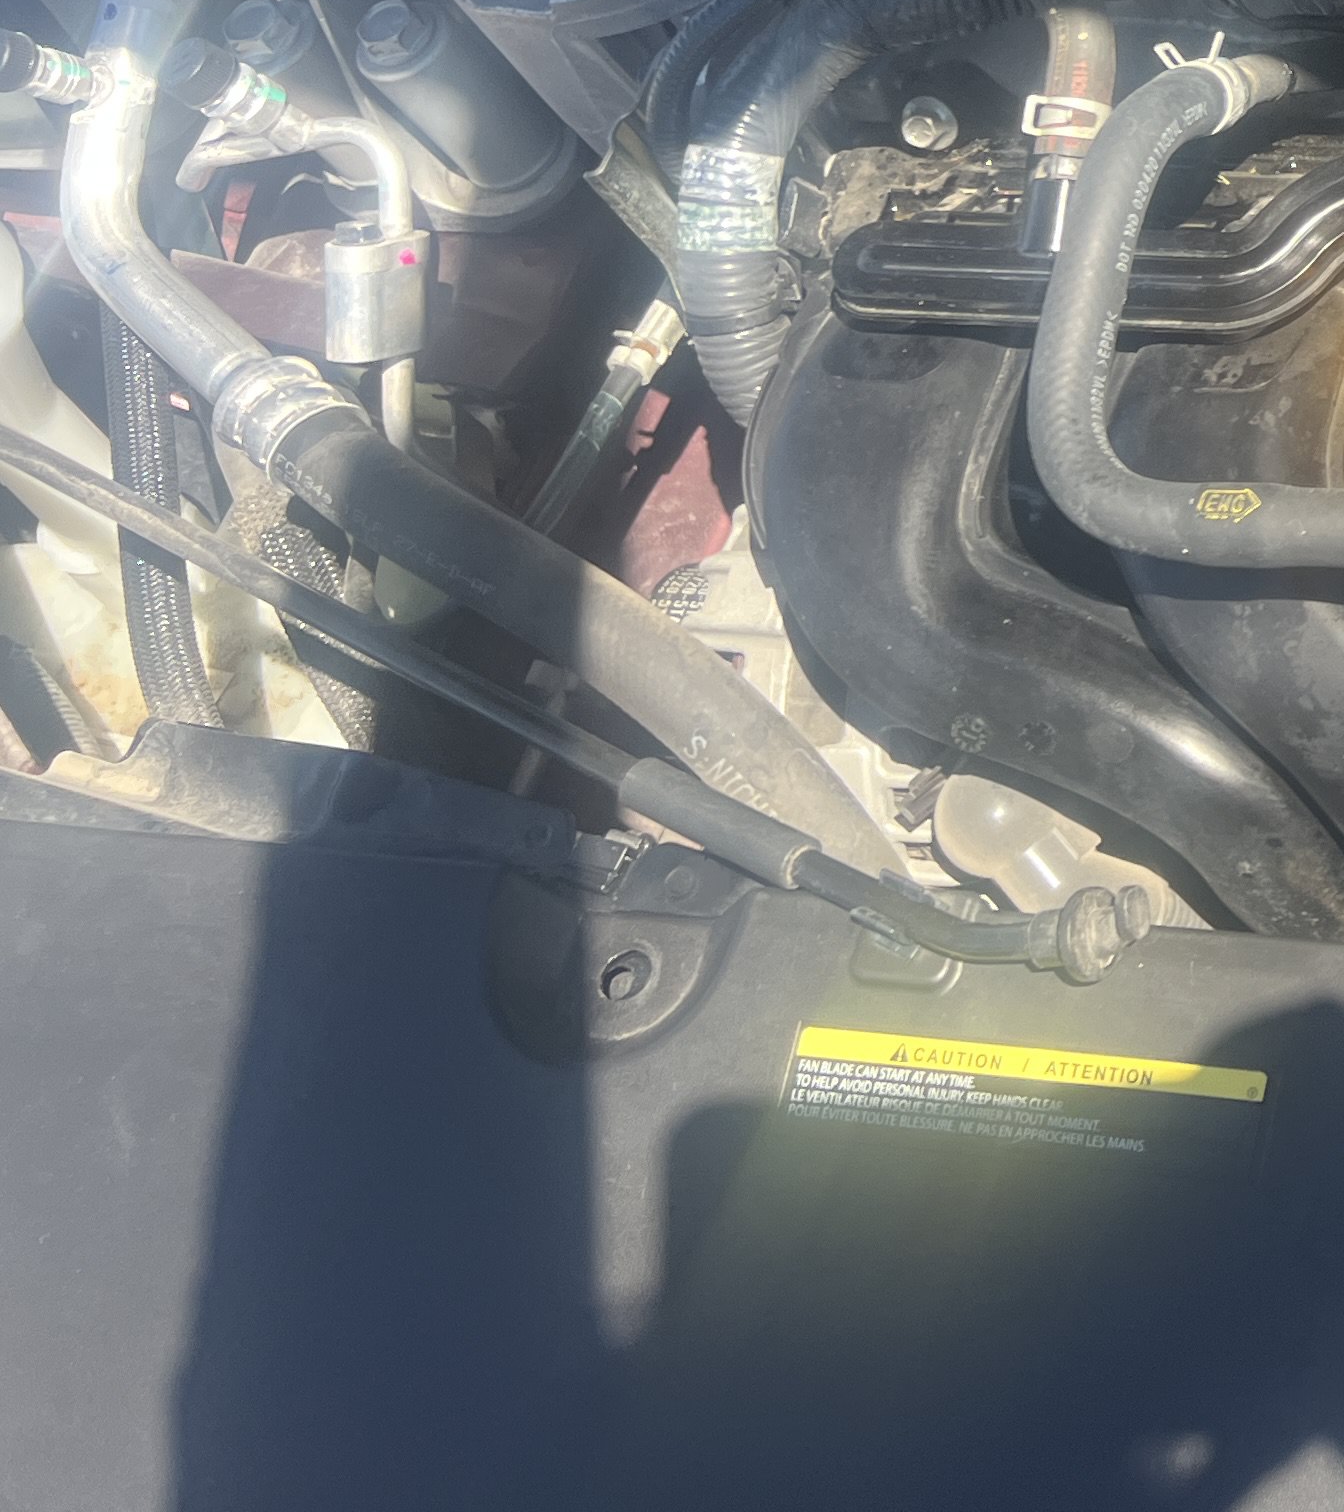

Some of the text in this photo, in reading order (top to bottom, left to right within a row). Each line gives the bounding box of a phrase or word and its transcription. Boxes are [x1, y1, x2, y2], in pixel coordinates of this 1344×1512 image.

[798, 1059, 818, 1071] FAN
[820, 1061, 855, 1075] BLADE
[855, 1065, 879, 1077] CAN
[879, 1067, 912, 1081] START
[911, 1072, 923, 1083] AT
[913, 1047, 1002, 1070] CAUTION
[1045, 1061, 1153, 1086] ATTENTION
[791, 1090, 805, 1101] LE
[806, 1091, 880, 1108] VENTILATEUR
[881, 1098, 924, 1113] RISQUE
[925, 1102, 941, 1114] DE
[1014, 1111, 1045, 1125] TOUT
[796, 1074, 812, 1087] TO
[812, 1076, 840, 1089] HELP
[840, 1079, 872, 1092] AVOID
[872, 1082, 926, 1098] PERSONAL
[966, 1091, 992, 1105] KEEP
[992, 1094, 1028, 1109] HANDS
[788, 1104, 819, 1117] POUR
[861, 1110, 898, 1126] TOUTE
[960, 1121, 973, 1135] NE
[976, 1122, 997, 1138] PAS
[1000, 1125, 1013, 1138] EN
[1014, 1126, 1085, 1145] APPROCHER
[1085, 1132, 1106, 1148] LES
